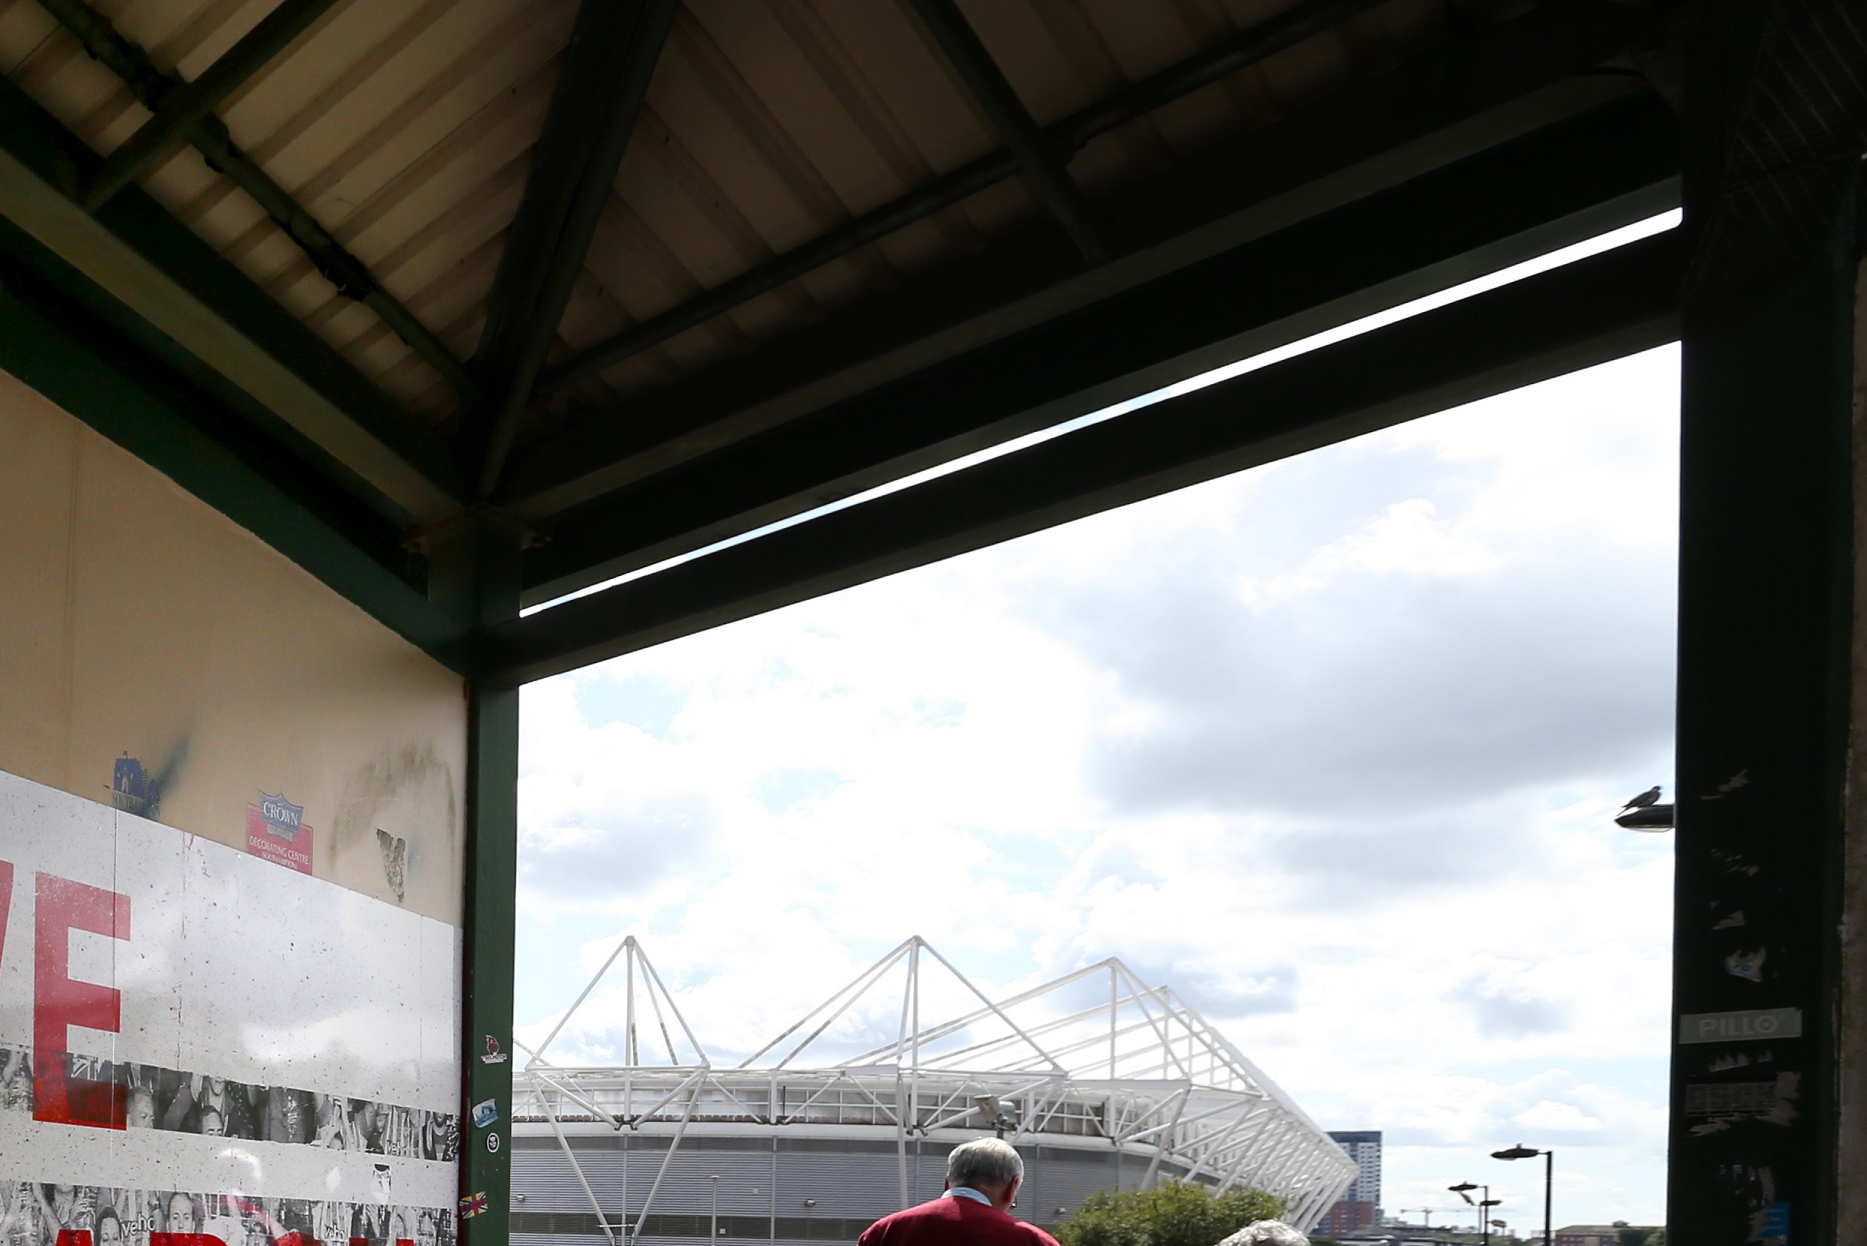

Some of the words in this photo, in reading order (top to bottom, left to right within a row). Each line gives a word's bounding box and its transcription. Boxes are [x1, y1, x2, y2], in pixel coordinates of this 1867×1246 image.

[263, 801, 298, 826] CROWN
[249, 835, 288, 858] DECORATING
[288, 850, 309, 865] CENTRE
[1699, 1015, 1777, 1037] PILLO
[121, 1213, 156, 1237] veho
